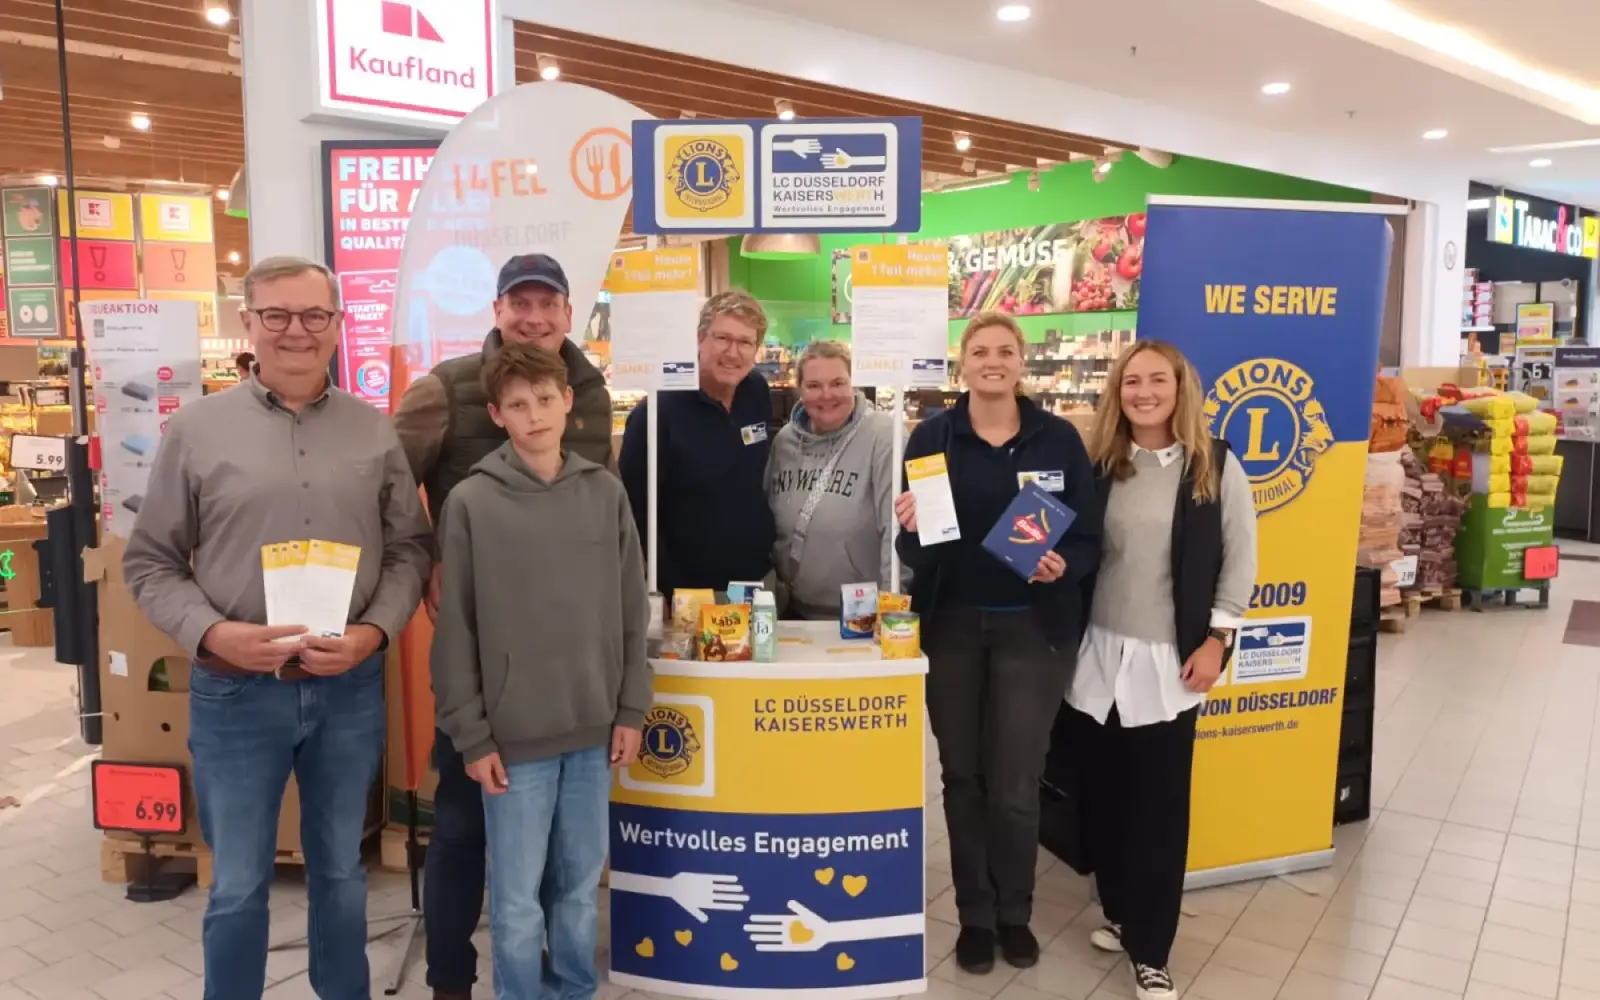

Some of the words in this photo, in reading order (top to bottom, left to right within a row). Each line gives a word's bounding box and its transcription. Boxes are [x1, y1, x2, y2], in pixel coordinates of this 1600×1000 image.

[349, 46, 476, 89] Kaufland
[682, 142, 725, 157] LIONS
[696, 162, 713, 187] L
[773, 177, 790, 188] LC
[340, 183, 398, 213] FÜR
[773, 189, 884, 201] KAISERSWERTH
[827, 203, 885, 214] Engagement
[340, 218, 357, 231] IN
[966, 237, 1070, 272] GEMÜSE
[1204, 284, 1246, 314] WE
[1253, 285, 1338, 316] SERVE
[1222, 362, 1308, 397] LIONS
[1242, 408, 1280, 461] L
[36, 454, 63, 466] 5.99
[1248, 581, 1307, 609] 2009
[754, 699, 776, 713] LC
[783, 695, 908, 713] DÜSSELDORF
[1199, 698, 1231, 716] VON
[1236, 687, 1338, 713] DÜSSELDORF
[645, 710, 686, 727] LIONS
[754, 714, 908, 732] KAISERSWERTH
[656, 729, 675, 753] L
[136, 801, 177, 822] 6.99
[619, 821, 747, 853] Wertvolles
[754, 828, 909, 858] Engagement
